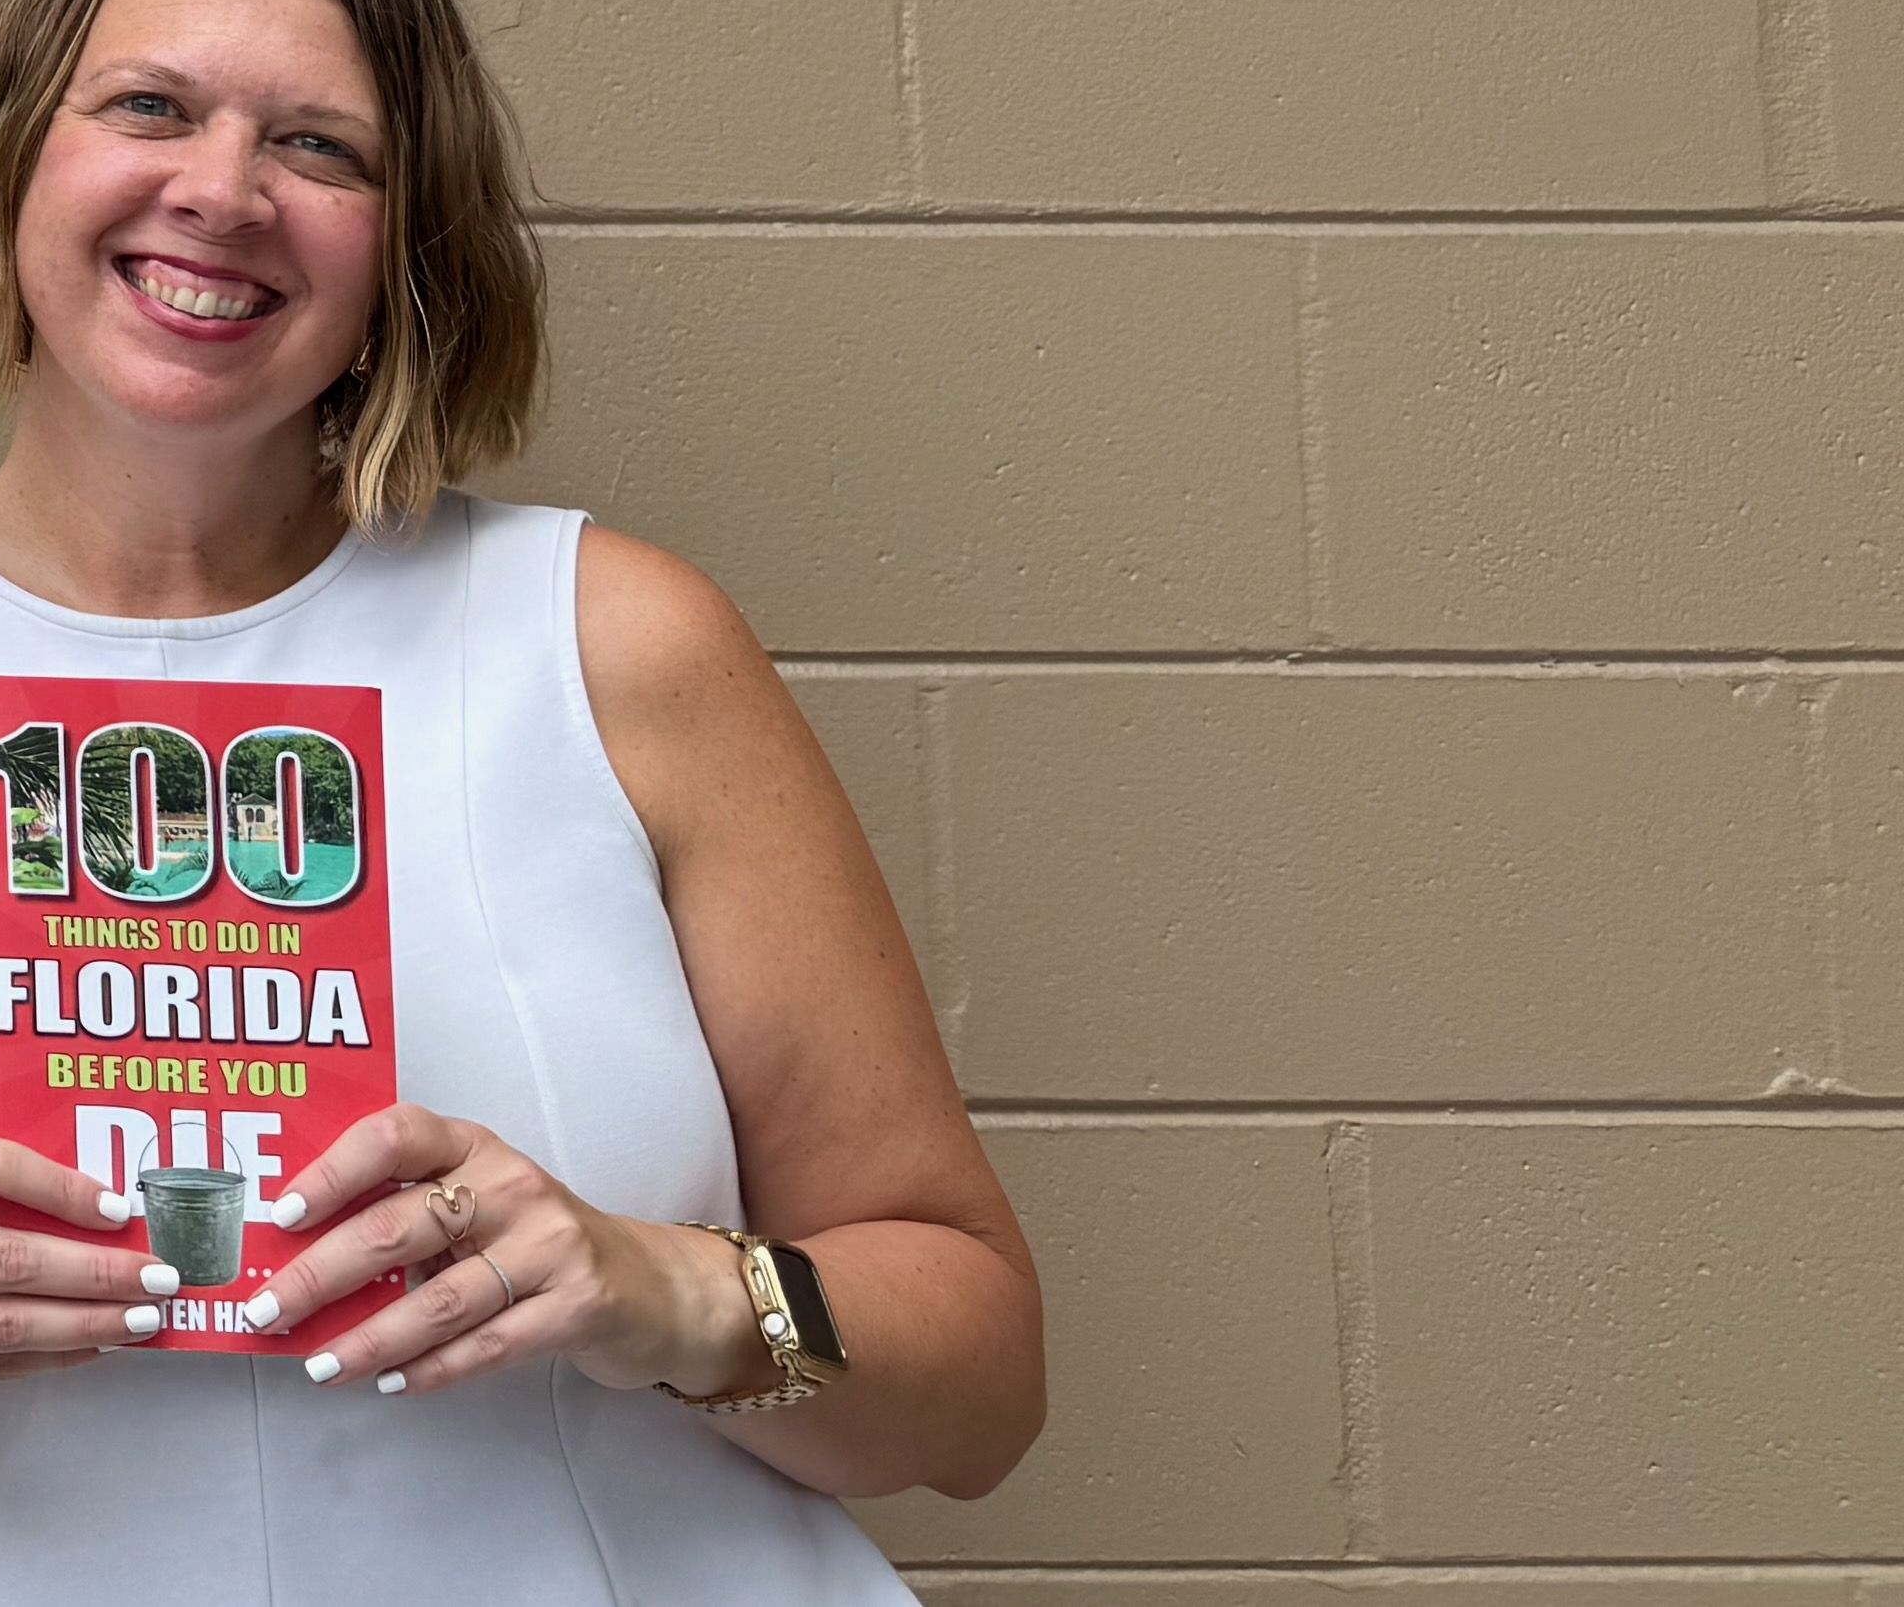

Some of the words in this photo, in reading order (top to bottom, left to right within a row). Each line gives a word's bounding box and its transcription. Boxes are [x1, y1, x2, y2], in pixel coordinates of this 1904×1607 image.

[43, 915, 160, 950] THINGS
[166, 919, 207, 952] TO
[217, 921, 259, 954] DO
[268, 924, 301, 955] IN
[47, 1053, 207, 1094] BEFORE
[218, 1060, 308, 1098] YOU
[75, 1105, 282, 1222] DIE
